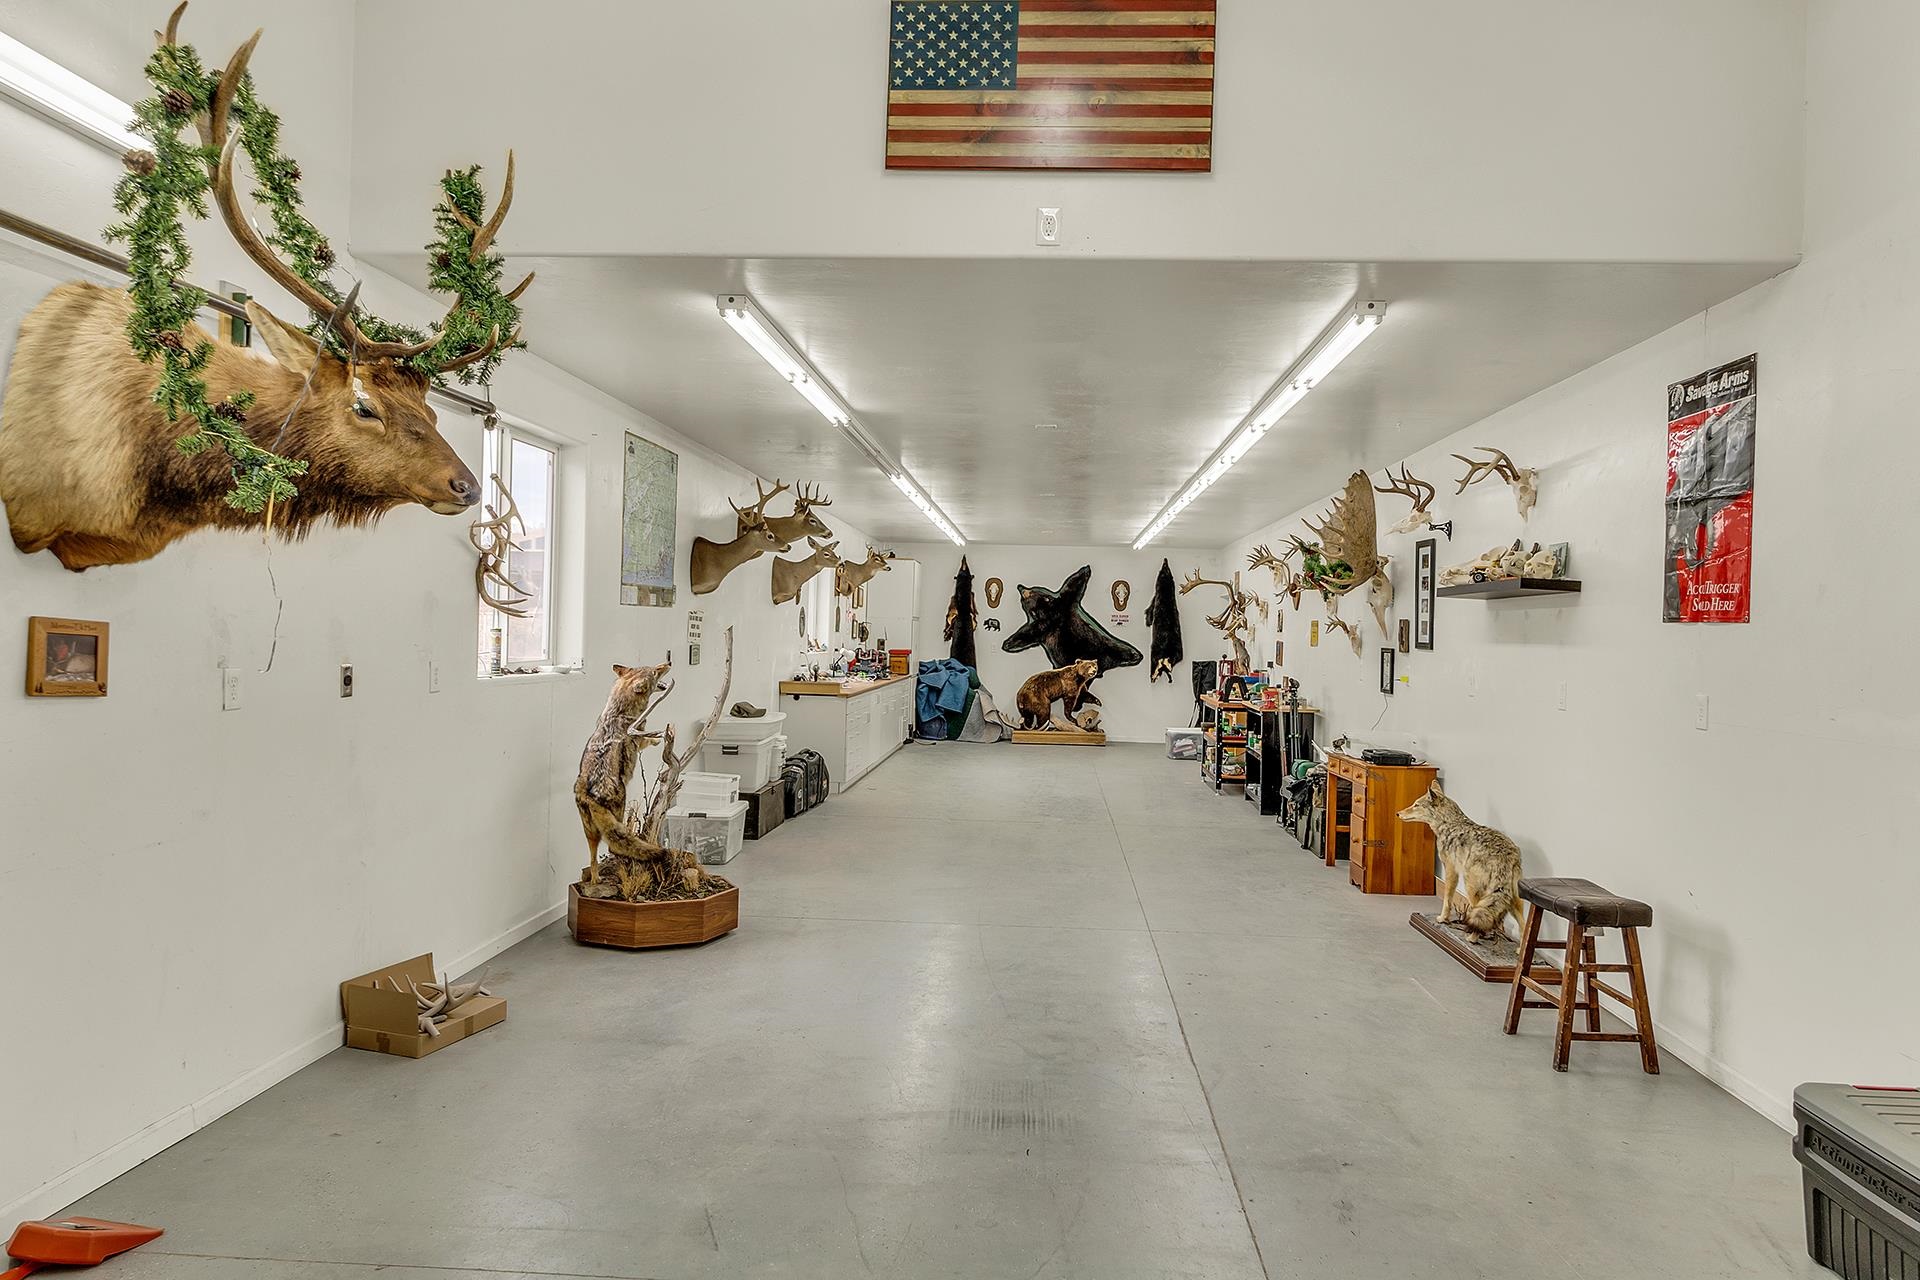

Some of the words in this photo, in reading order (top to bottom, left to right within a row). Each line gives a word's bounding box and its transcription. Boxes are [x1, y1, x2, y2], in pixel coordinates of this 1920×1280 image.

[1685, 379, 1719, 403] Savage
[1719, 370, 1750, 391] Arms
[1710, 597, 1736, 611] HERE
